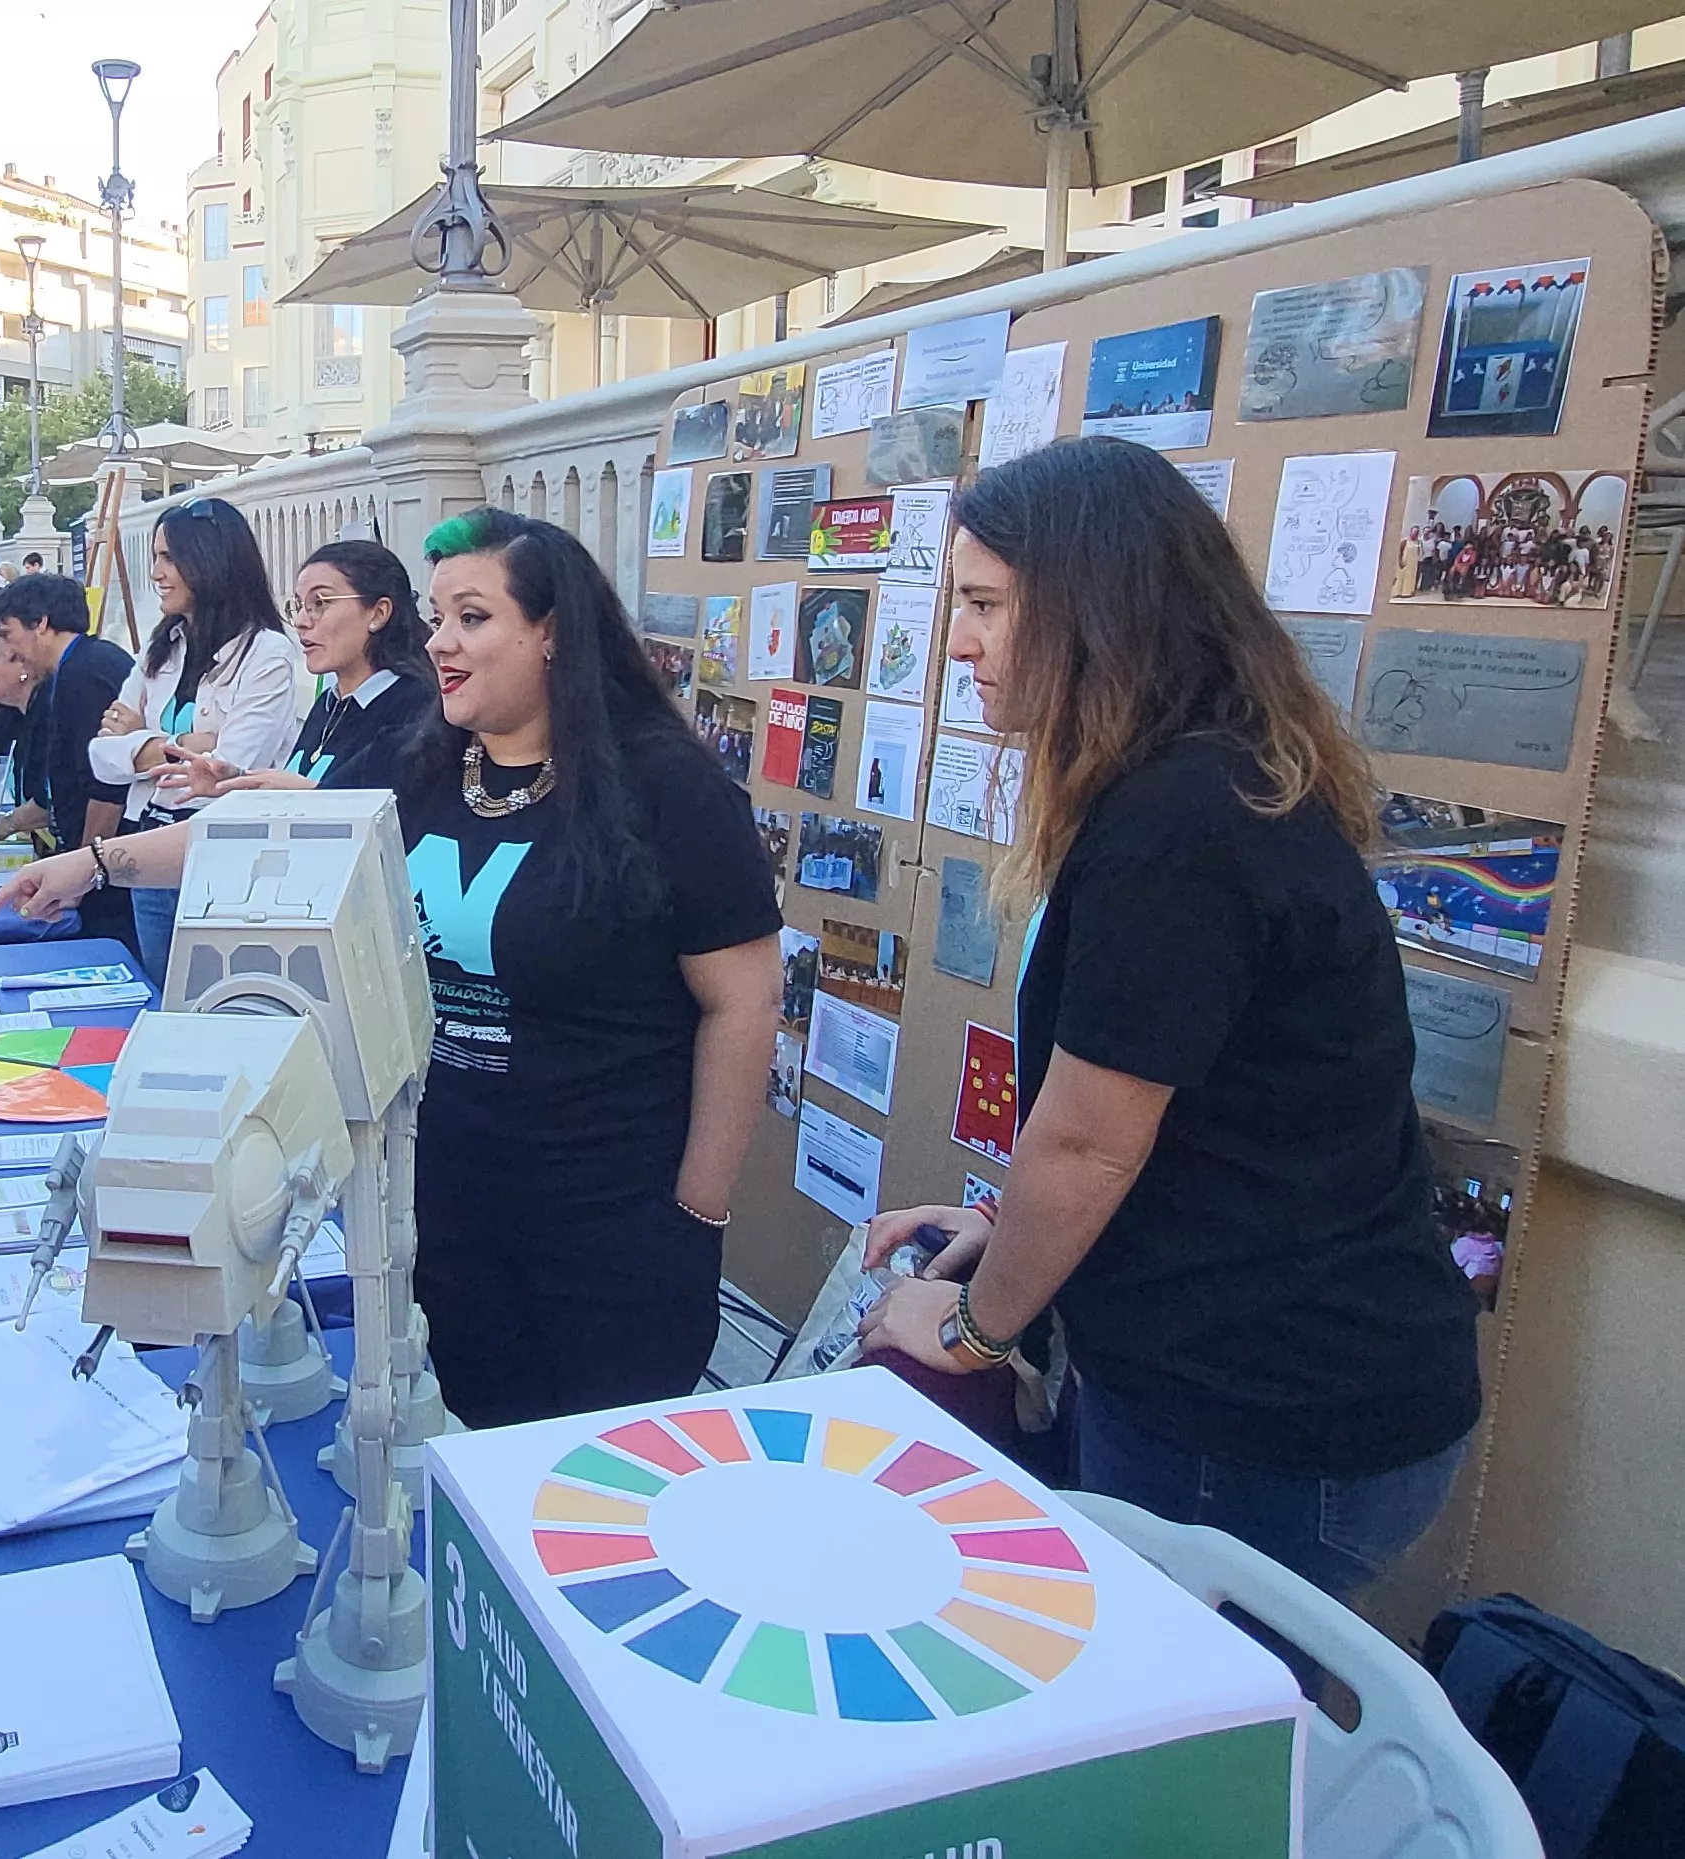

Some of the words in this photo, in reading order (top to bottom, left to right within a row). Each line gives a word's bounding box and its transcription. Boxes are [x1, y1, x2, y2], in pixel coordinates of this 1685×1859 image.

[768, 710, 783, 726] DE
[770, 699, 787, 713] CON
[787, 702, 806, 716] OJOS
[430, 984, 511, 1007] STIGADORAS
[446, 1541, 466, 1651] 3
[479, 1590, 528, 1699] SALUD
[479, 1648, 489, 1695] Y
[493, 1677, 578, 1859] BIENESTAR
